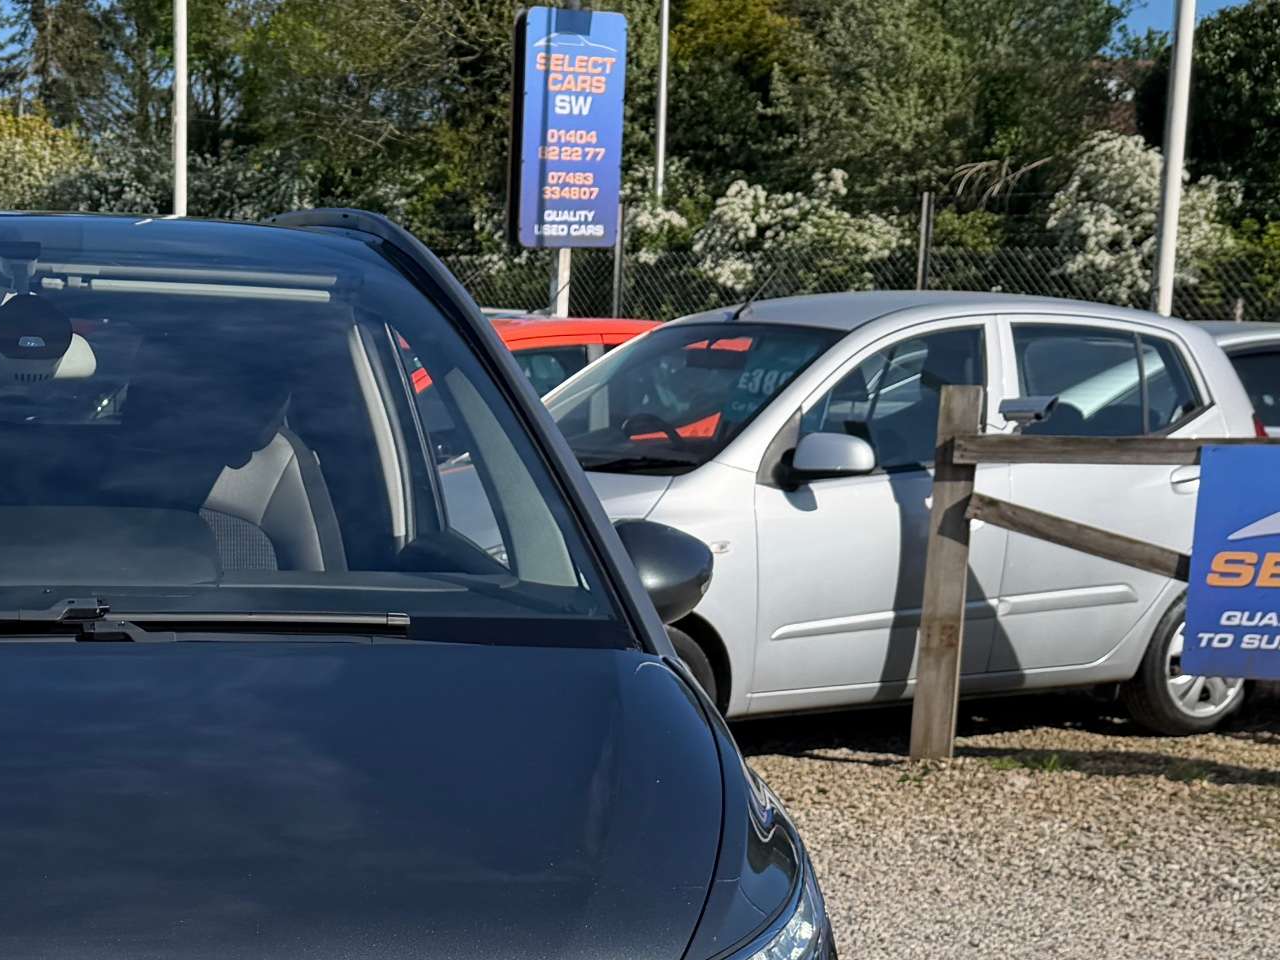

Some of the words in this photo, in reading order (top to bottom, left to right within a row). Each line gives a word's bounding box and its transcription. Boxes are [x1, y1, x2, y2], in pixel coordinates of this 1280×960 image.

[536, 52, 616, 74] SELECT
[548, 73, 606, 94] CARS
[554, 94, 593, 115] SW
[547, 129, 597, 144] 01404
[544, 210, 595, 222] QUALITY
[569, 224, 605, 236] CARS
[1220, 611, 1280, 627] QUA
[1197, 633, 1235, 648] TO
[1240, 634, 1280, 650] SU
